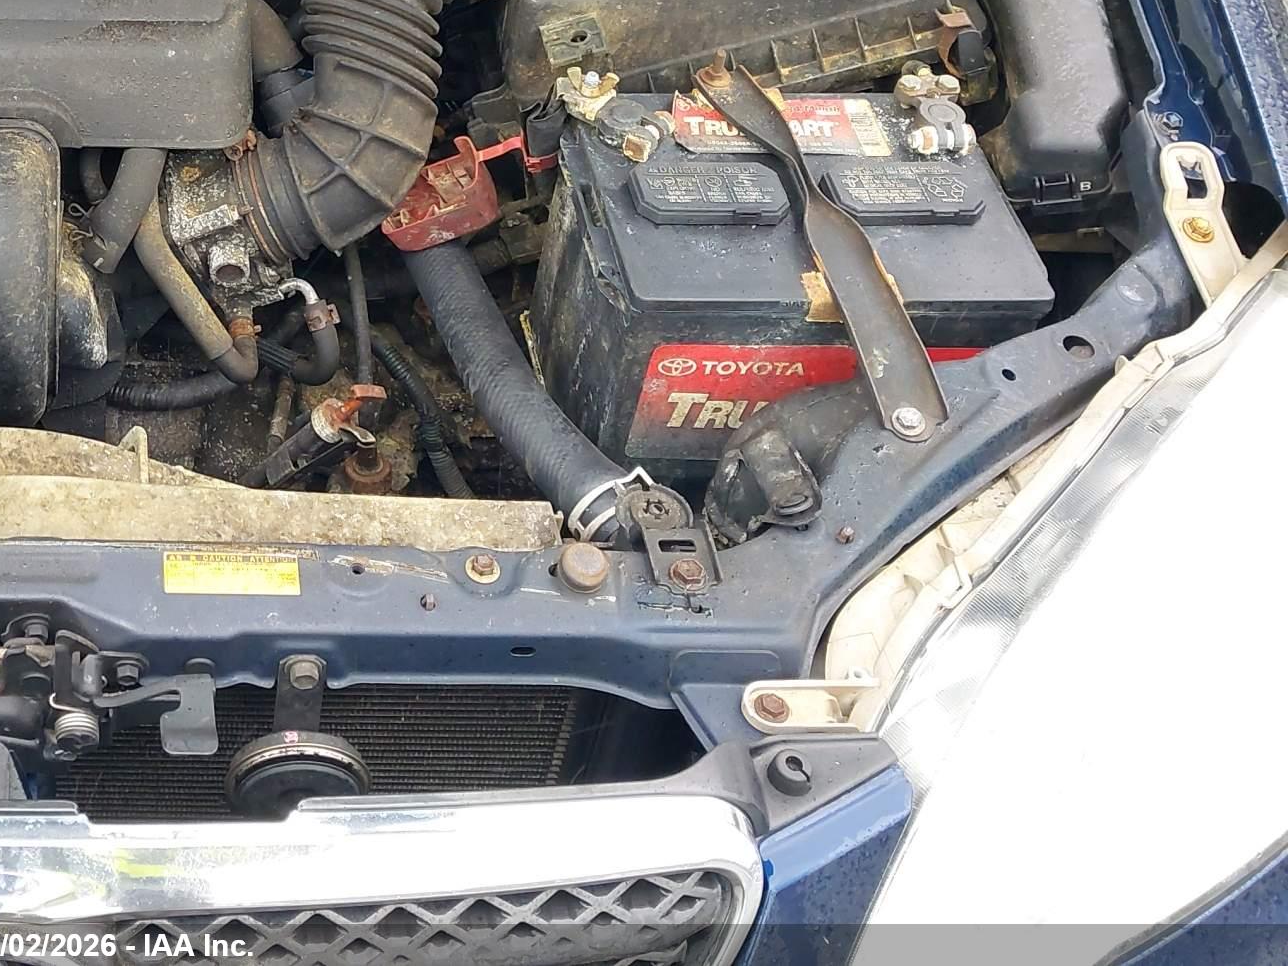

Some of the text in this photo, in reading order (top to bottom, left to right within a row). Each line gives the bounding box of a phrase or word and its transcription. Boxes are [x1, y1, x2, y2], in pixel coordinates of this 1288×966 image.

[658, 166, 705, 174] DANGER
[1079, 181, 1092, 192] B
[700, 360, 805, 377] TOYOTA
[202, 554, 244, 563] CAUTION
